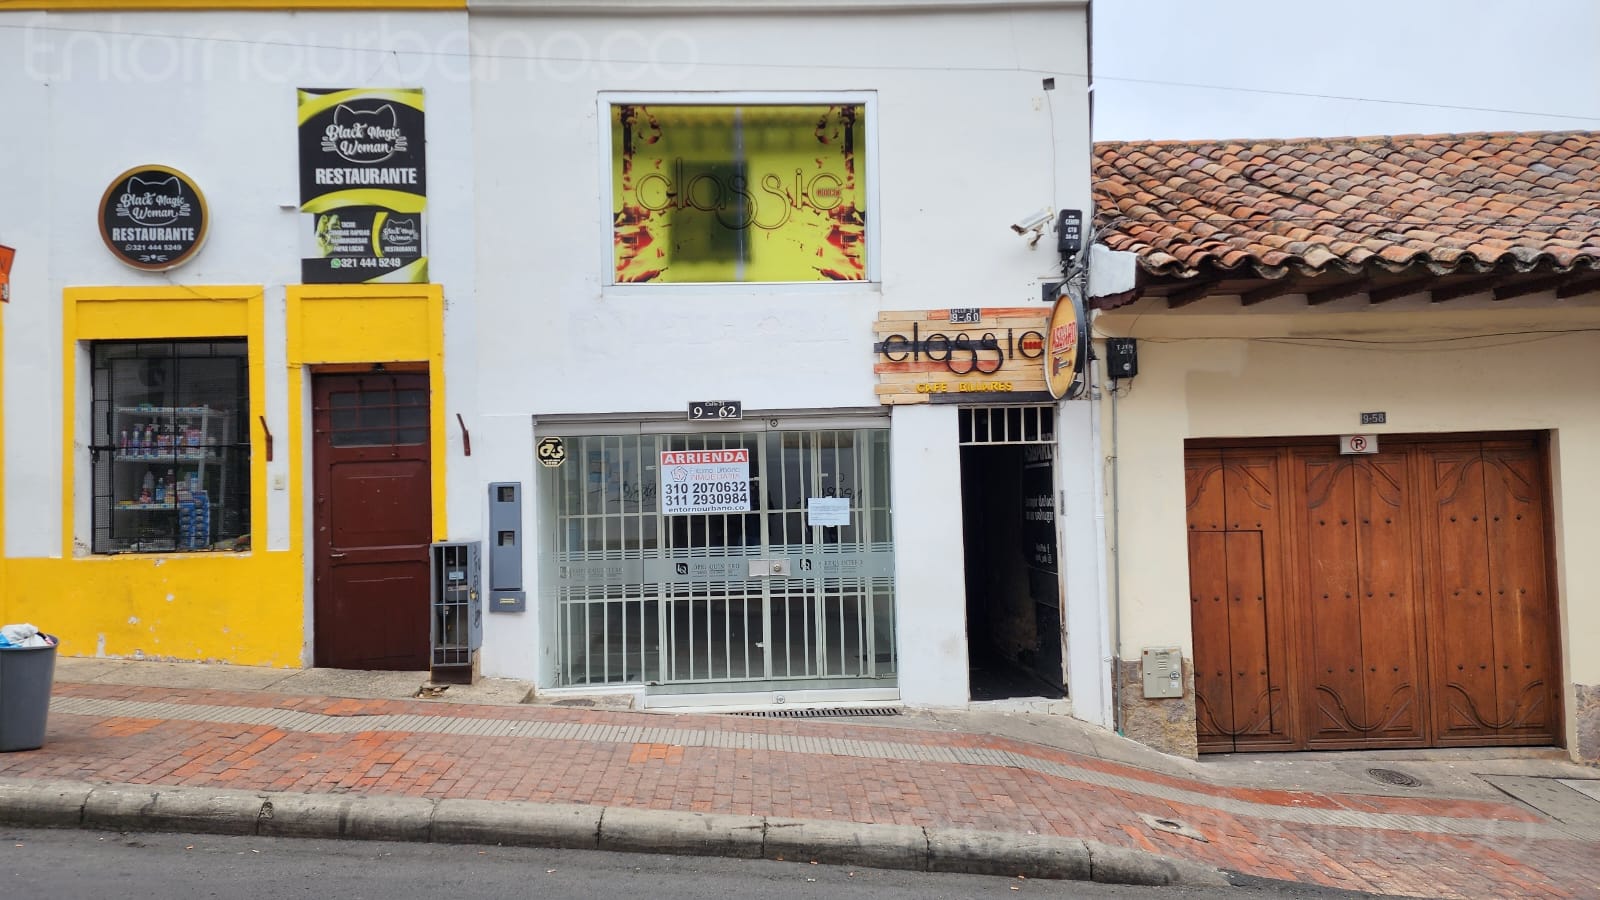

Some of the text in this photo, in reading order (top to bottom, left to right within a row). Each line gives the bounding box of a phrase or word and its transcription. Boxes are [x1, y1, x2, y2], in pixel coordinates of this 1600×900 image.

[325, 122, 400, 141] Black Magic
[340, 140, 393, 155] Woman
[315, 168, 417, 185] RESTAURANTE
[120, 192, 185, 208] Black Magic
[635, 157, 844, 230] classic
[132, 207, 179, 219] Woman
[112, 228, 194, 241] RESTAURANTE
[341, 257, 401, 268] 321 444 5249
[916, 381, 1013, 392] CAFE BILLARES
[693, 406, 703, 418] 9
[718, 405, 737, 418] 62
[1363, 413, 1384, 424] 9-58
[664, 451, 746, 464] ARRIENDA
[665, 483, 688, 494] 310
[692, 481, 746, 493] 2070632
[665, 493, 747, 505] 311 2930984
[668, 505, 744, 513] entornourbano.co
